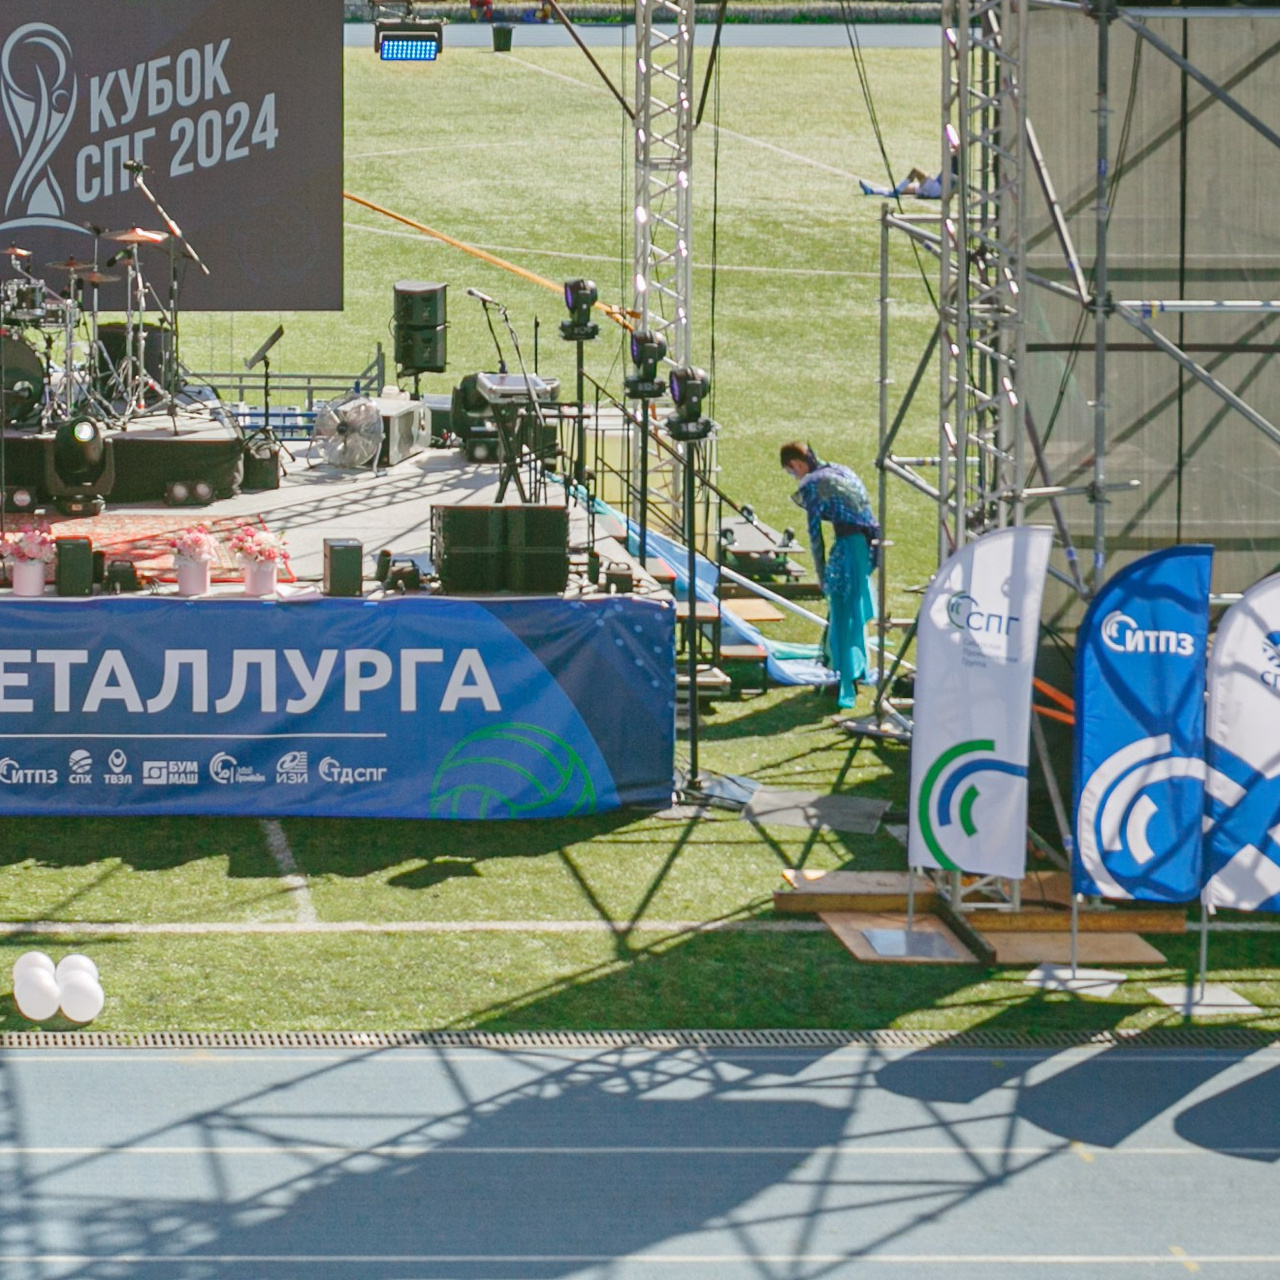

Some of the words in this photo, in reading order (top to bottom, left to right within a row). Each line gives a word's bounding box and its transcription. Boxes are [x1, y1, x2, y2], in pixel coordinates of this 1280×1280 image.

[89, 37, 232, 134] КУБОК
[76, 126, 156, 203] СПГ
[169, 92, 279, 178] 2024
[168, 761, 198, 772] БУМ
[69, 774, 93, 784] СПХ
[103, 774, 132, 784] ТВЭЛ
[168, 773, 198, 784] МАШ
[276, 773, 308, 783] ИЗИ
